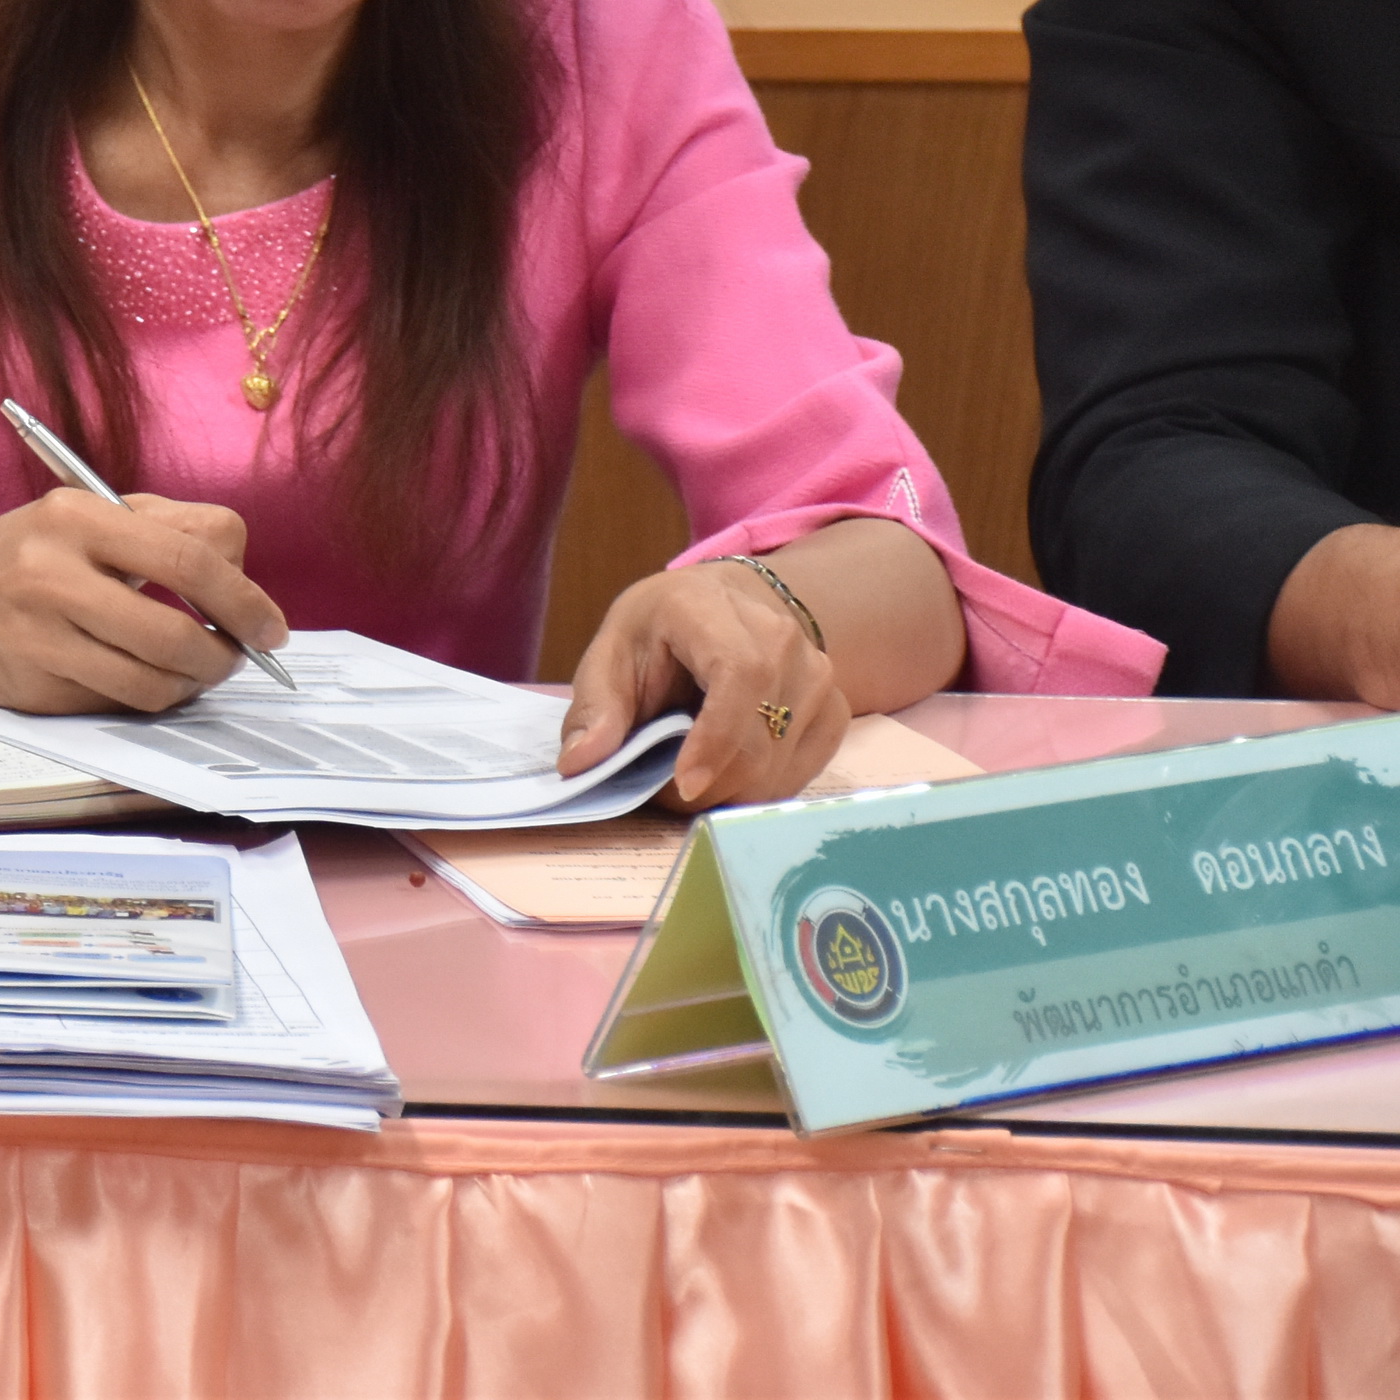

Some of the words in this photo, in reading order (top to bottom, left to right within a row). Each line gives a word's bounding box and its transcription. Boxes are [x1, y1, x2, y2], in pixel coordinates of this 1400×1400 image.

[889, 859, 1150, 952] นางสกุลทอง
[1194, 820, 1386, 898] ดอนกลาง
[1012, 940, 1360, 1045] พัฒนาการอำเภอแกดำ
